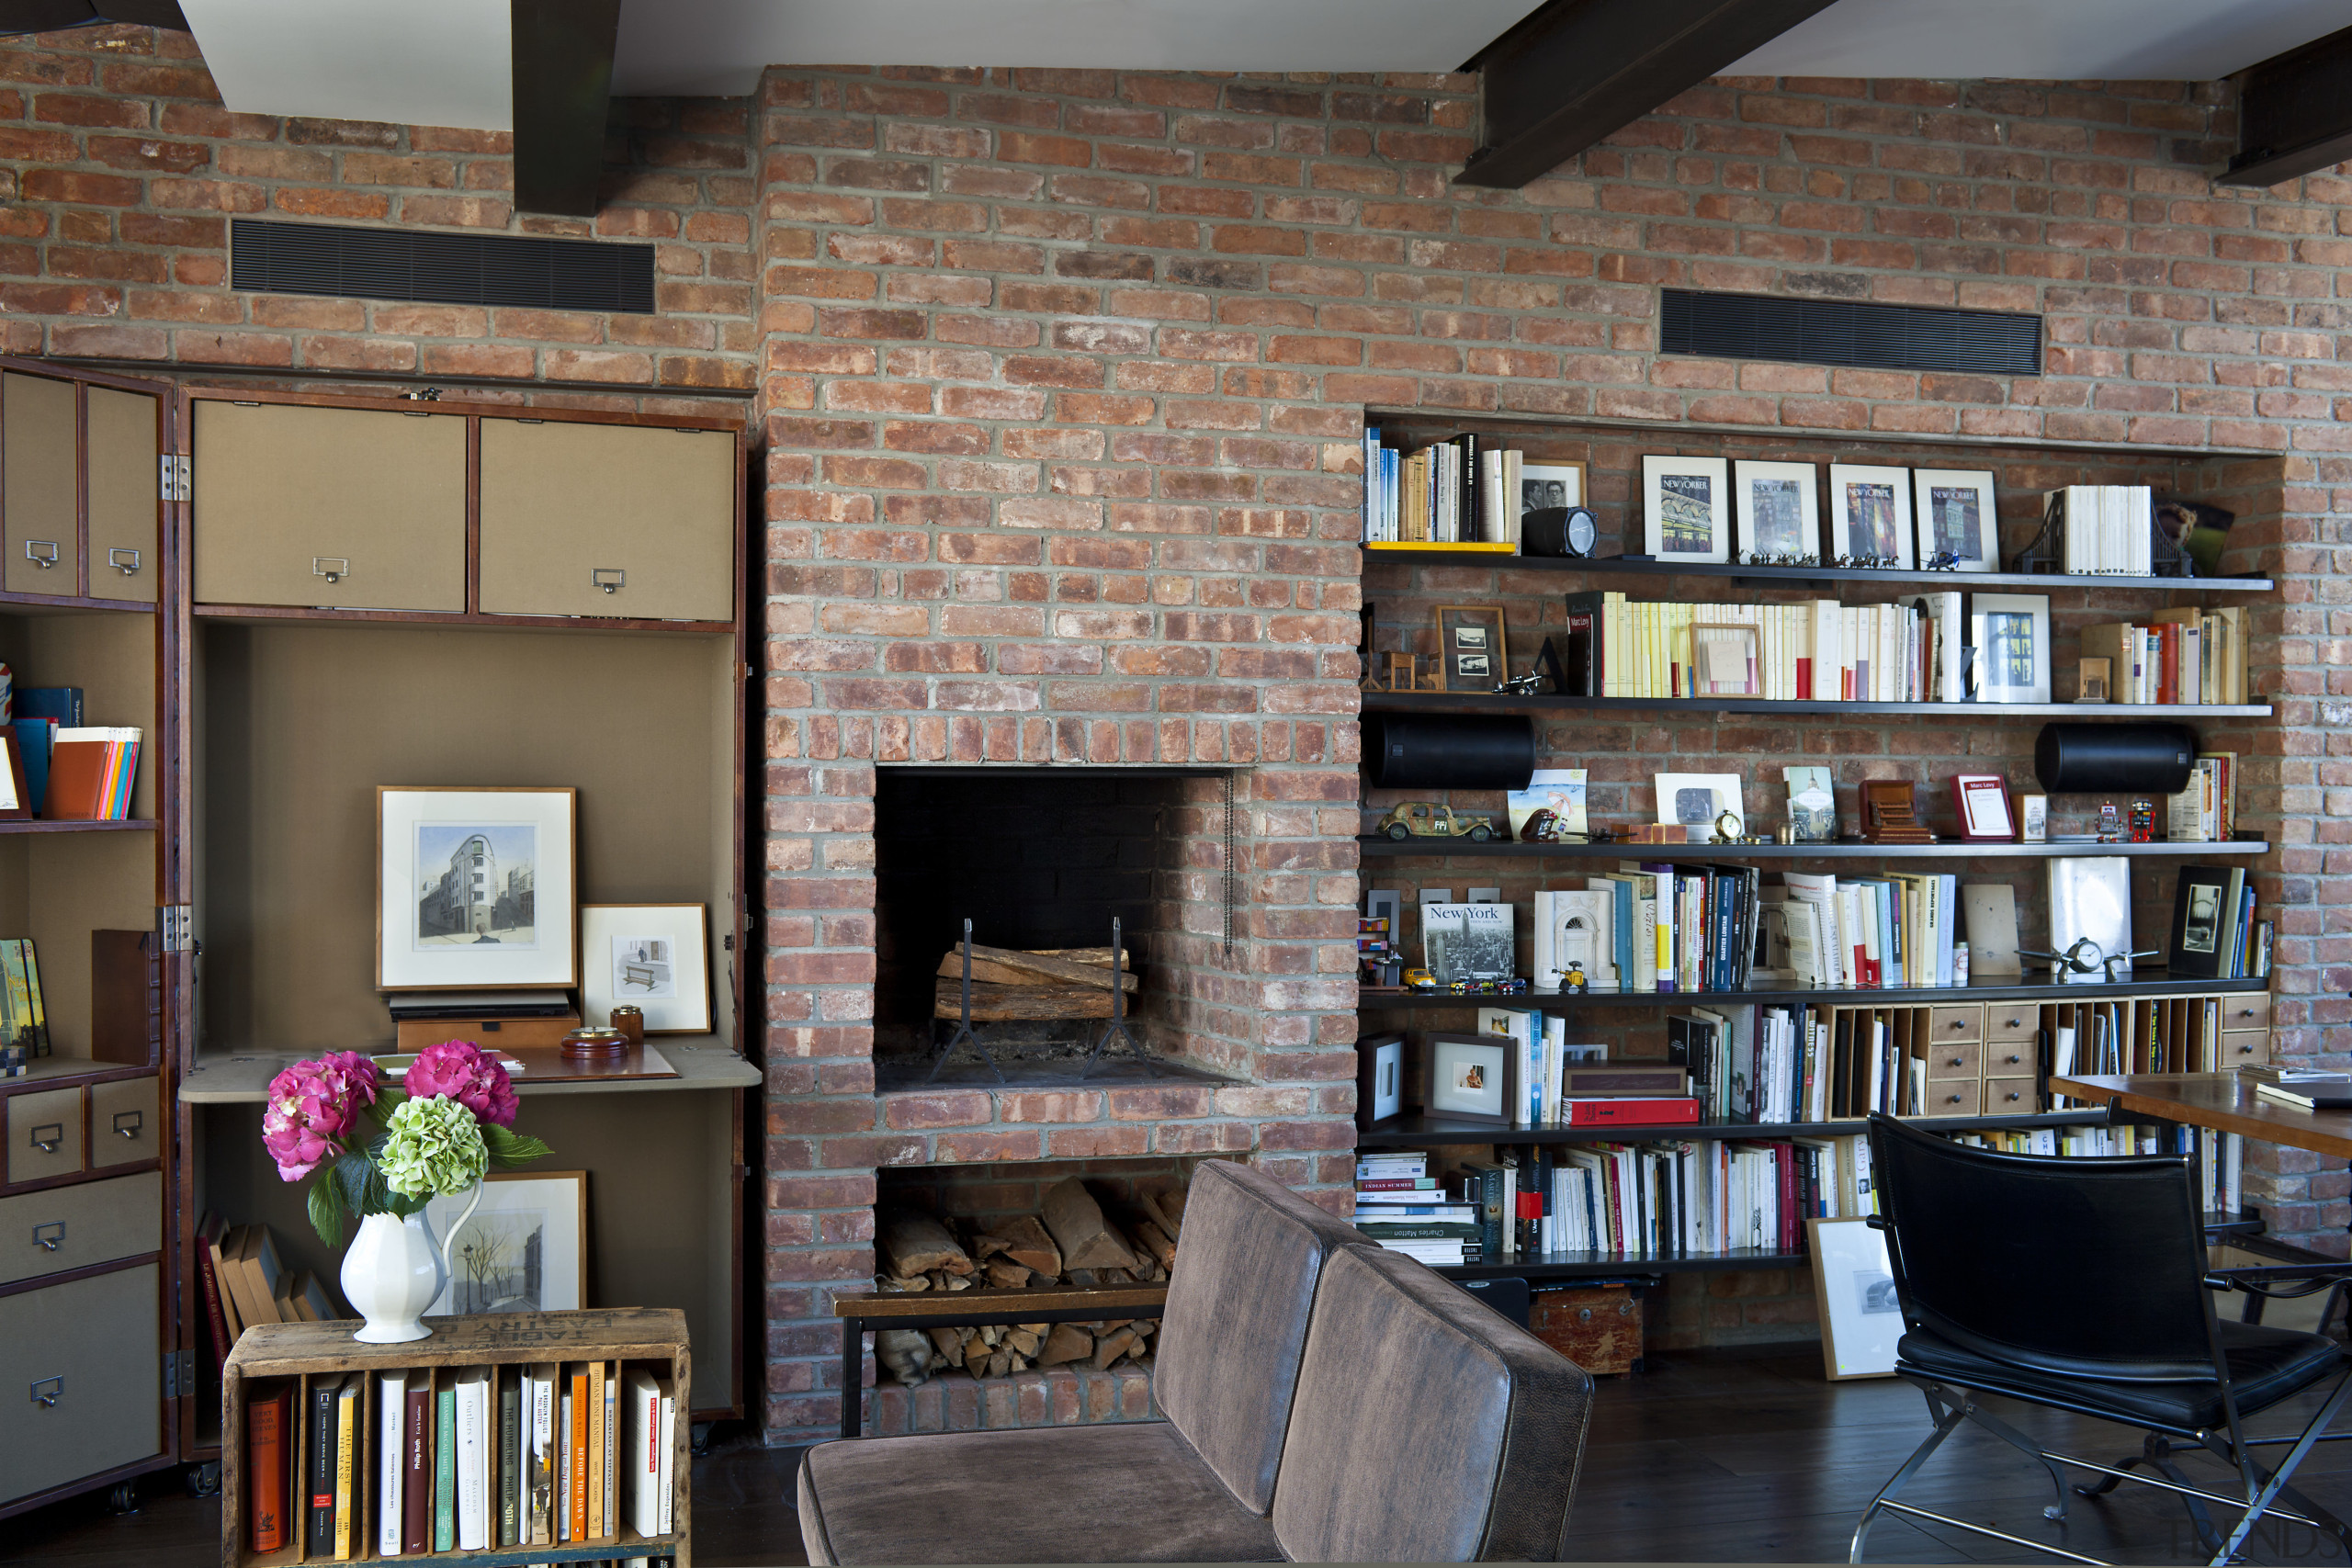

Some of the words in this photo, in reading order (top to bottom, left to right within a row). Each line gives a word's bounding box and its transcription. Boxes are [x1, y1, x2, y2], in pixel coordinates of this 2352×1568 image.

[1663, 479, 1679, 488] NEW
[1680, 480, 1707, 490] YORKER
[1848, 489, 1863, 497] NEW
[1863, 490, 1890, 499] YORKER
[1949, 492, 1974, 501] YORKER
[1430, 907, 1464, 919] New
[1466, 907, 1499, 919] York
[1807, 1020, 1816, 1057] WITNESS
[1856, 1138, 1867, 1172] Gary
[1487, 1172, 1496, 1204] MARTIN
[1811, 1185, 1819, 1218] Kabbalah
[1419, 1229, 1444, 1237] Charles
[476, 1330, 590, 1343] TABLE
[466, 1400, 474, 1436] Outliers
[505, 1406, 514, 1421] THE
[505, 1424, 514, 1466] HUMBLING
[413, 1453, 422, 1470] Philip
[560, 1466, 569, 1481] Dog
[560, 1482, 569, 1497] New
